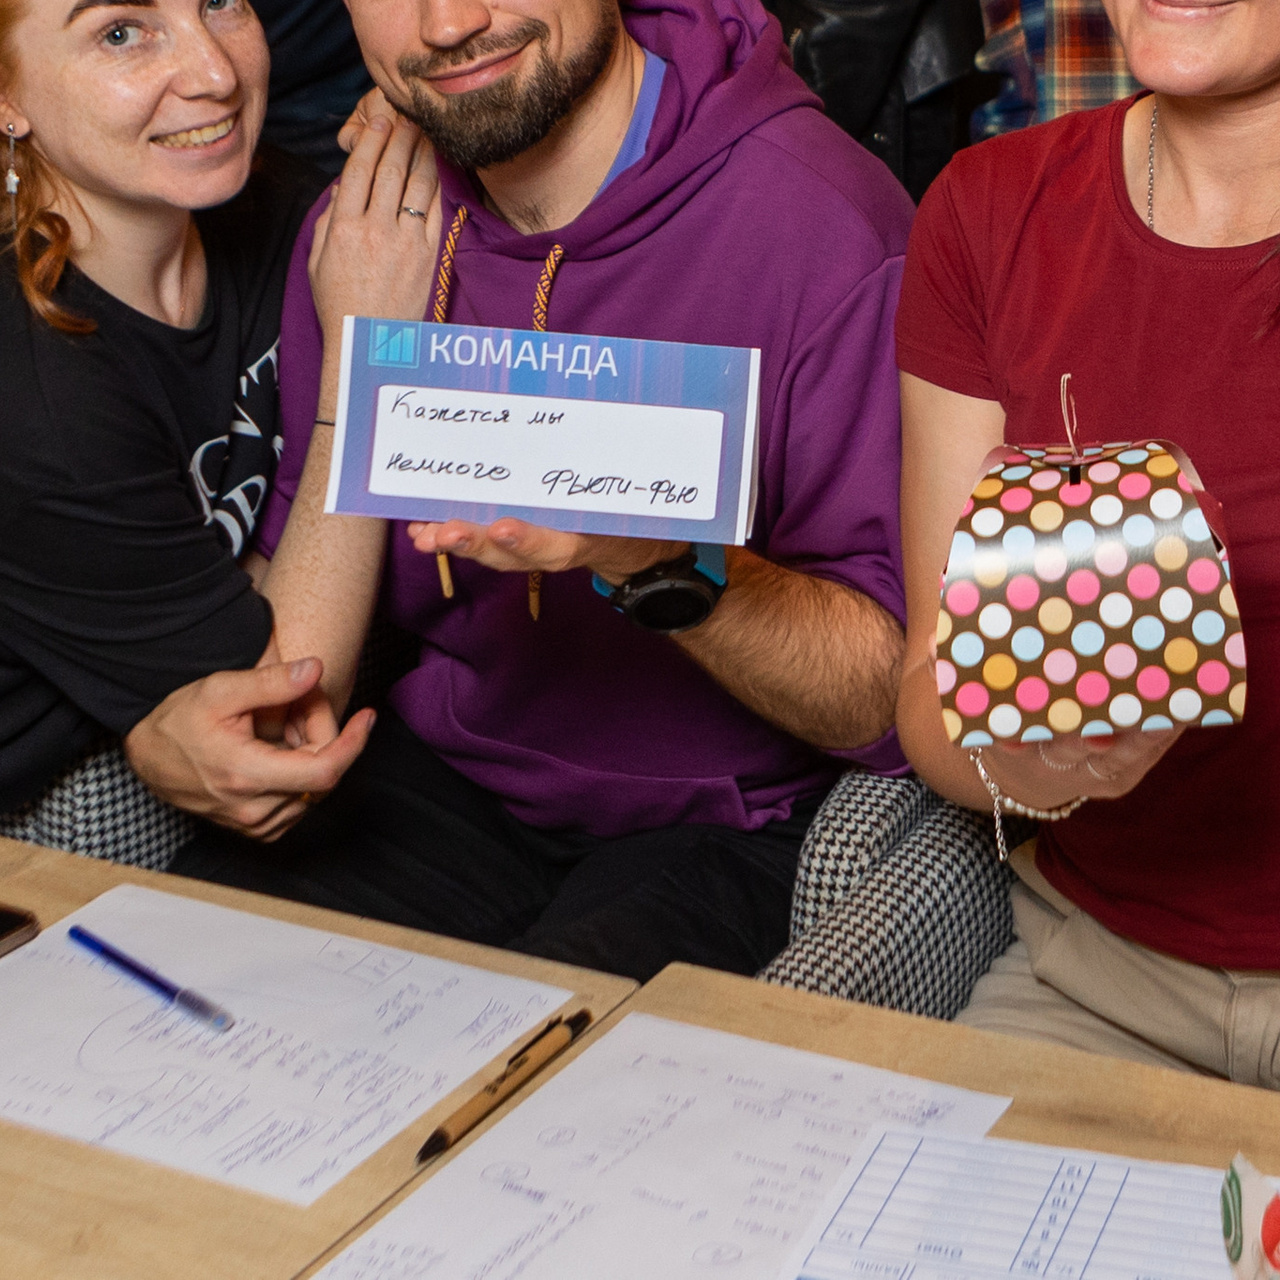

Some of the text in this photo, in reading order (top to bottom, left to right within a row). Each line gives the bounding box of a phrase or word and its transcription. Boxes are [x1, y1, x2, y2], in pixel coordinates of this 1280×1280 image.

[429, 333, 618, 380] КОМАНДА
[391, 390, 566, 426] Кажется мы
